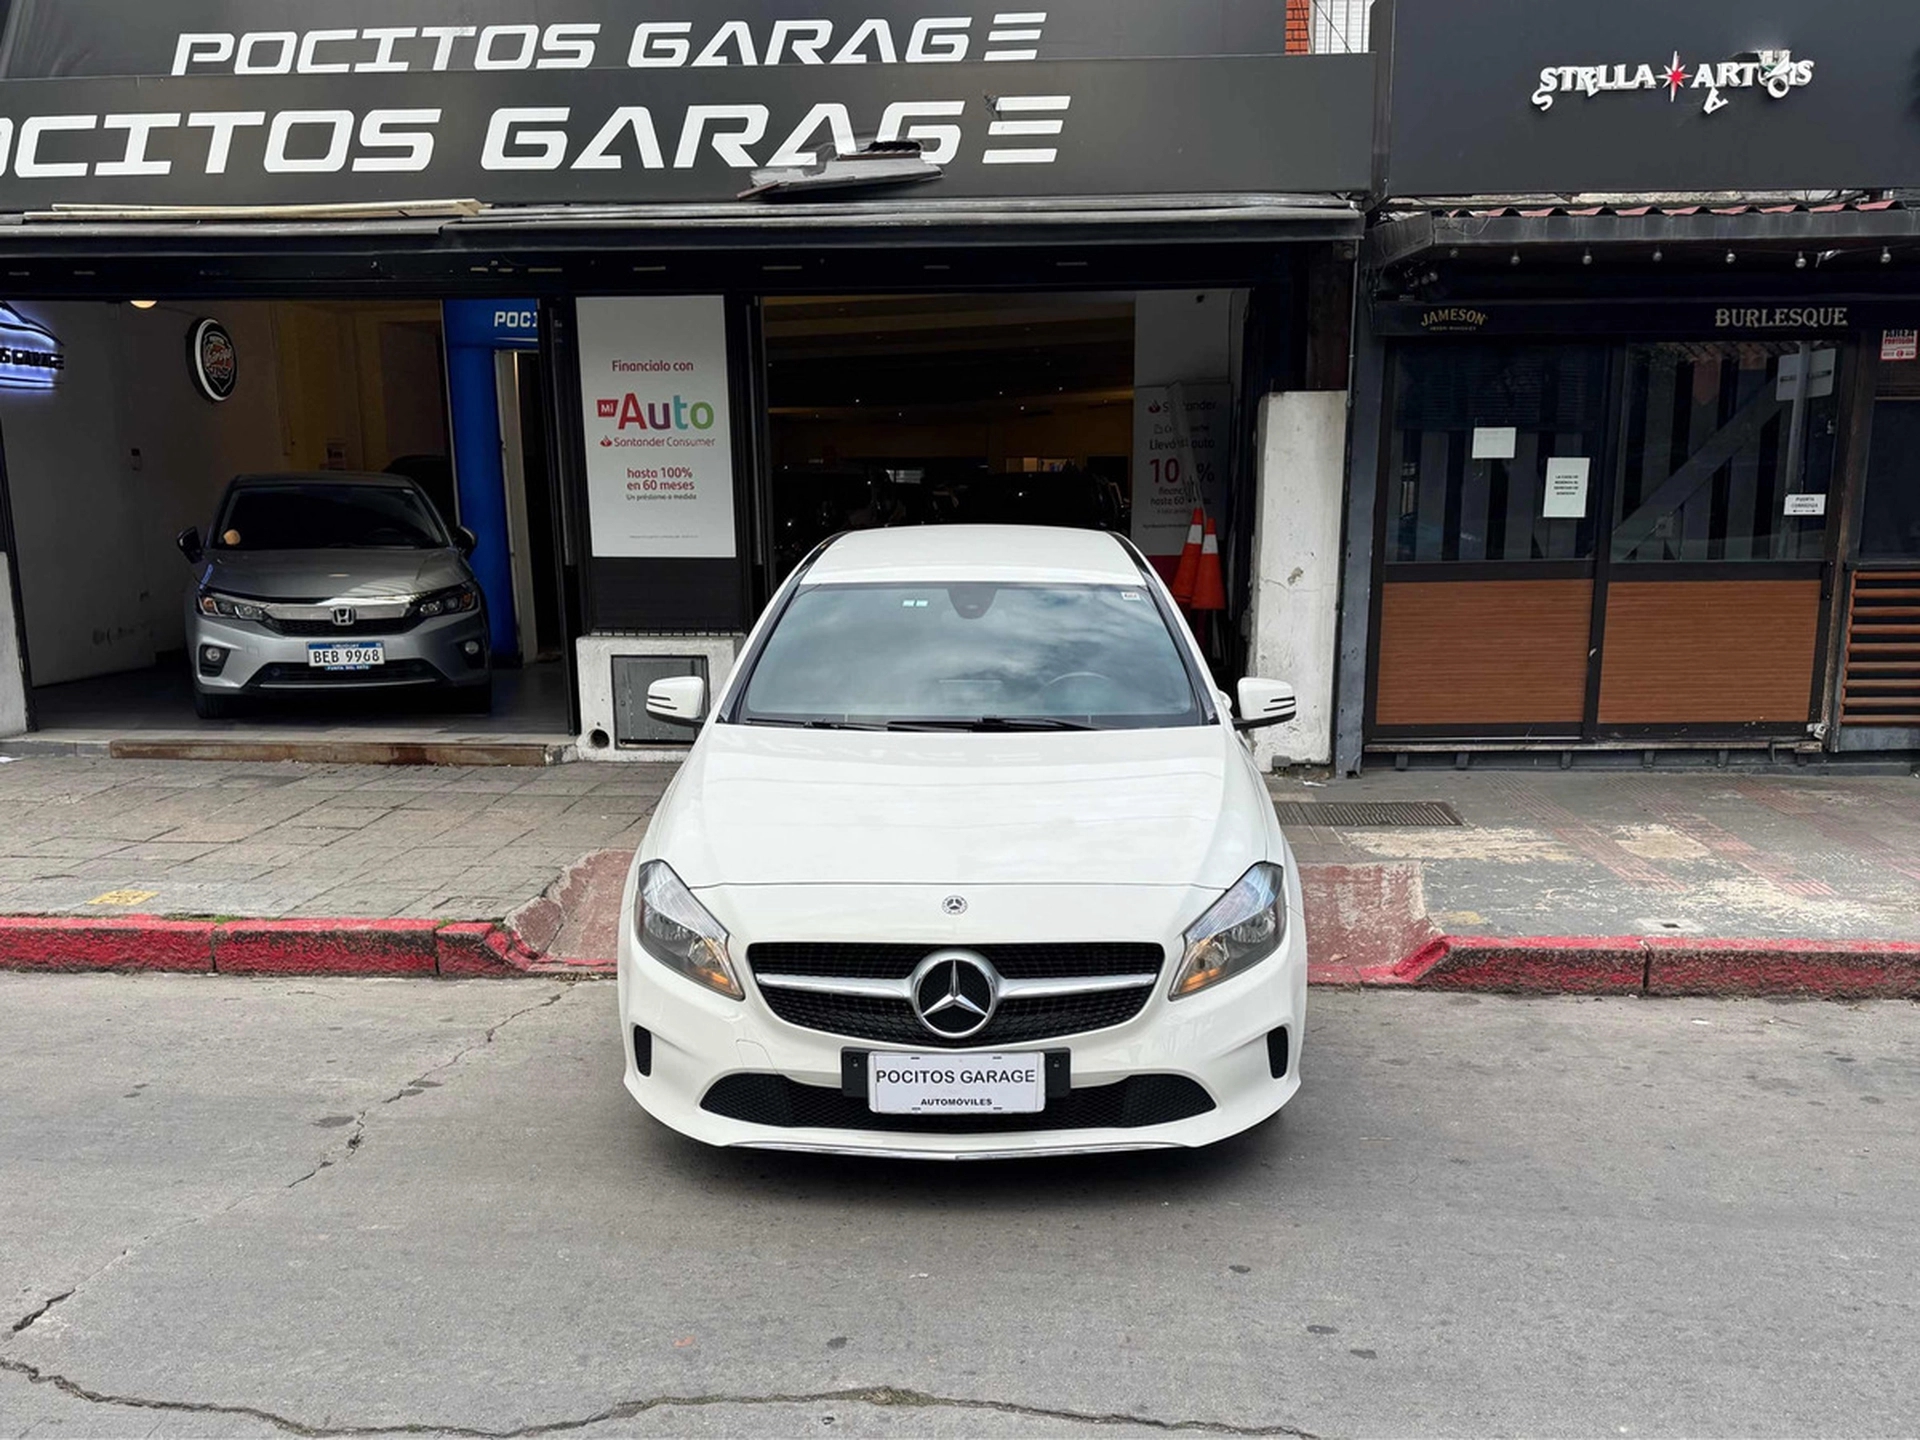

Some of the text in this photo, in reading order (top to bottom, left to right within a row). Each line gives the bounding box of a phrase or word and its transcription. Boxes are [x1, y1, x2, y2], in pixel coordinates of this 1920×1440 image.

[171, 12, 1047, 76] POCITOS GARAGE
[0, 96, 1071, 178] CITOS GARAGE
[1420, 308, 1486, 327] JAMESON
[1715, 307, 1849, 328] BURLESQUE
[612, 360, 694, 372] Financialo con
[618, 393, 714, 430] Auto
[613, 437, 716, 447] Santander Consumer
[626, 467, 693, 479] hasta 100%
[626, 480, 695, 491] en 60 meses
[313, 649, 380, 664] BEB 9968
[876, 1069, 1036, 1084] POCITOS GARAGE
[920, 1097, 993, 1106] AUTOMÓVILES
